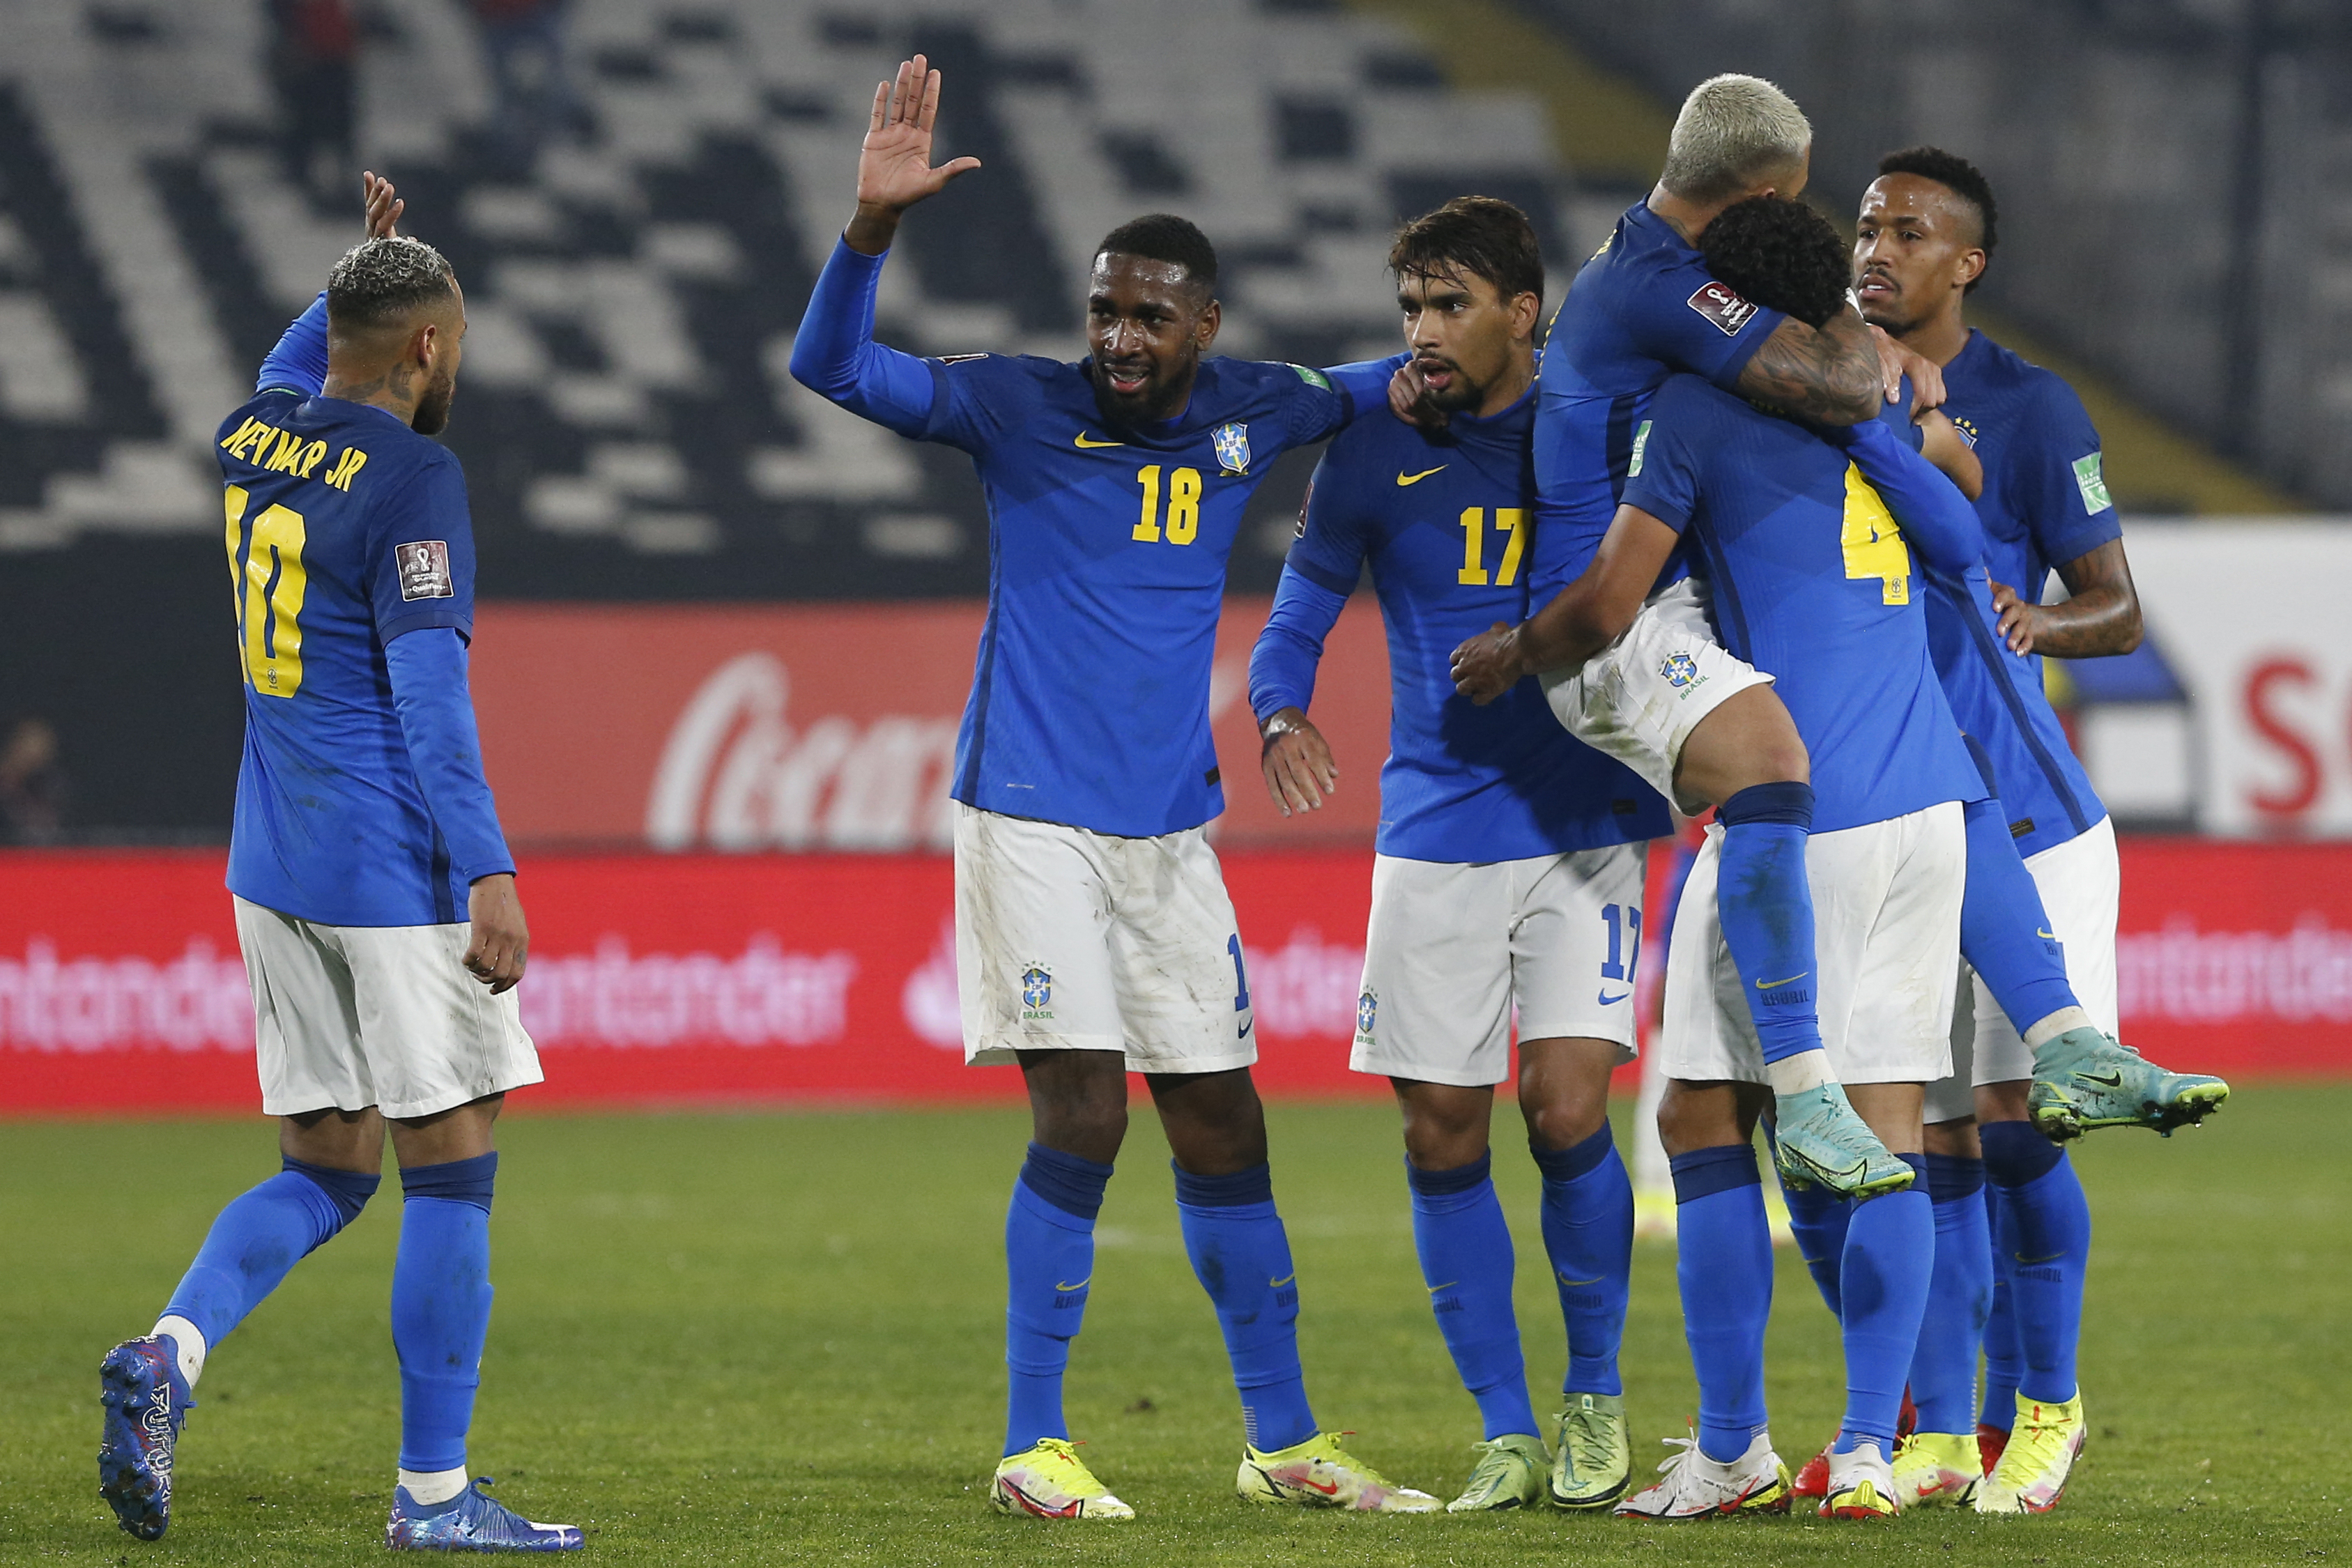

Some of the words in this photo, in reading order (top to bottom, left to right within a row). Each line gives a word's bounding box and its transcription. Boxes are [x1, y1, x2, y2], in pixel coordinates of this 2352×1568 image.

[220, 415, 328, 479] NEYMAR
[324, 447, 368, 492] JR
[1132, 464, 1202, 545] 18
[1840, 459, 1911, 606] 4
[1458, 507, 1532, 585] 17
[224, 484, 307, 698] 10
[1680, 675, 1709, 700] BRASIL
[1227, 933, 1249, 1011] 1
[1601, 903, 1641, 984] 17
[1023, 1011, 1054, 1020] BRASIL
